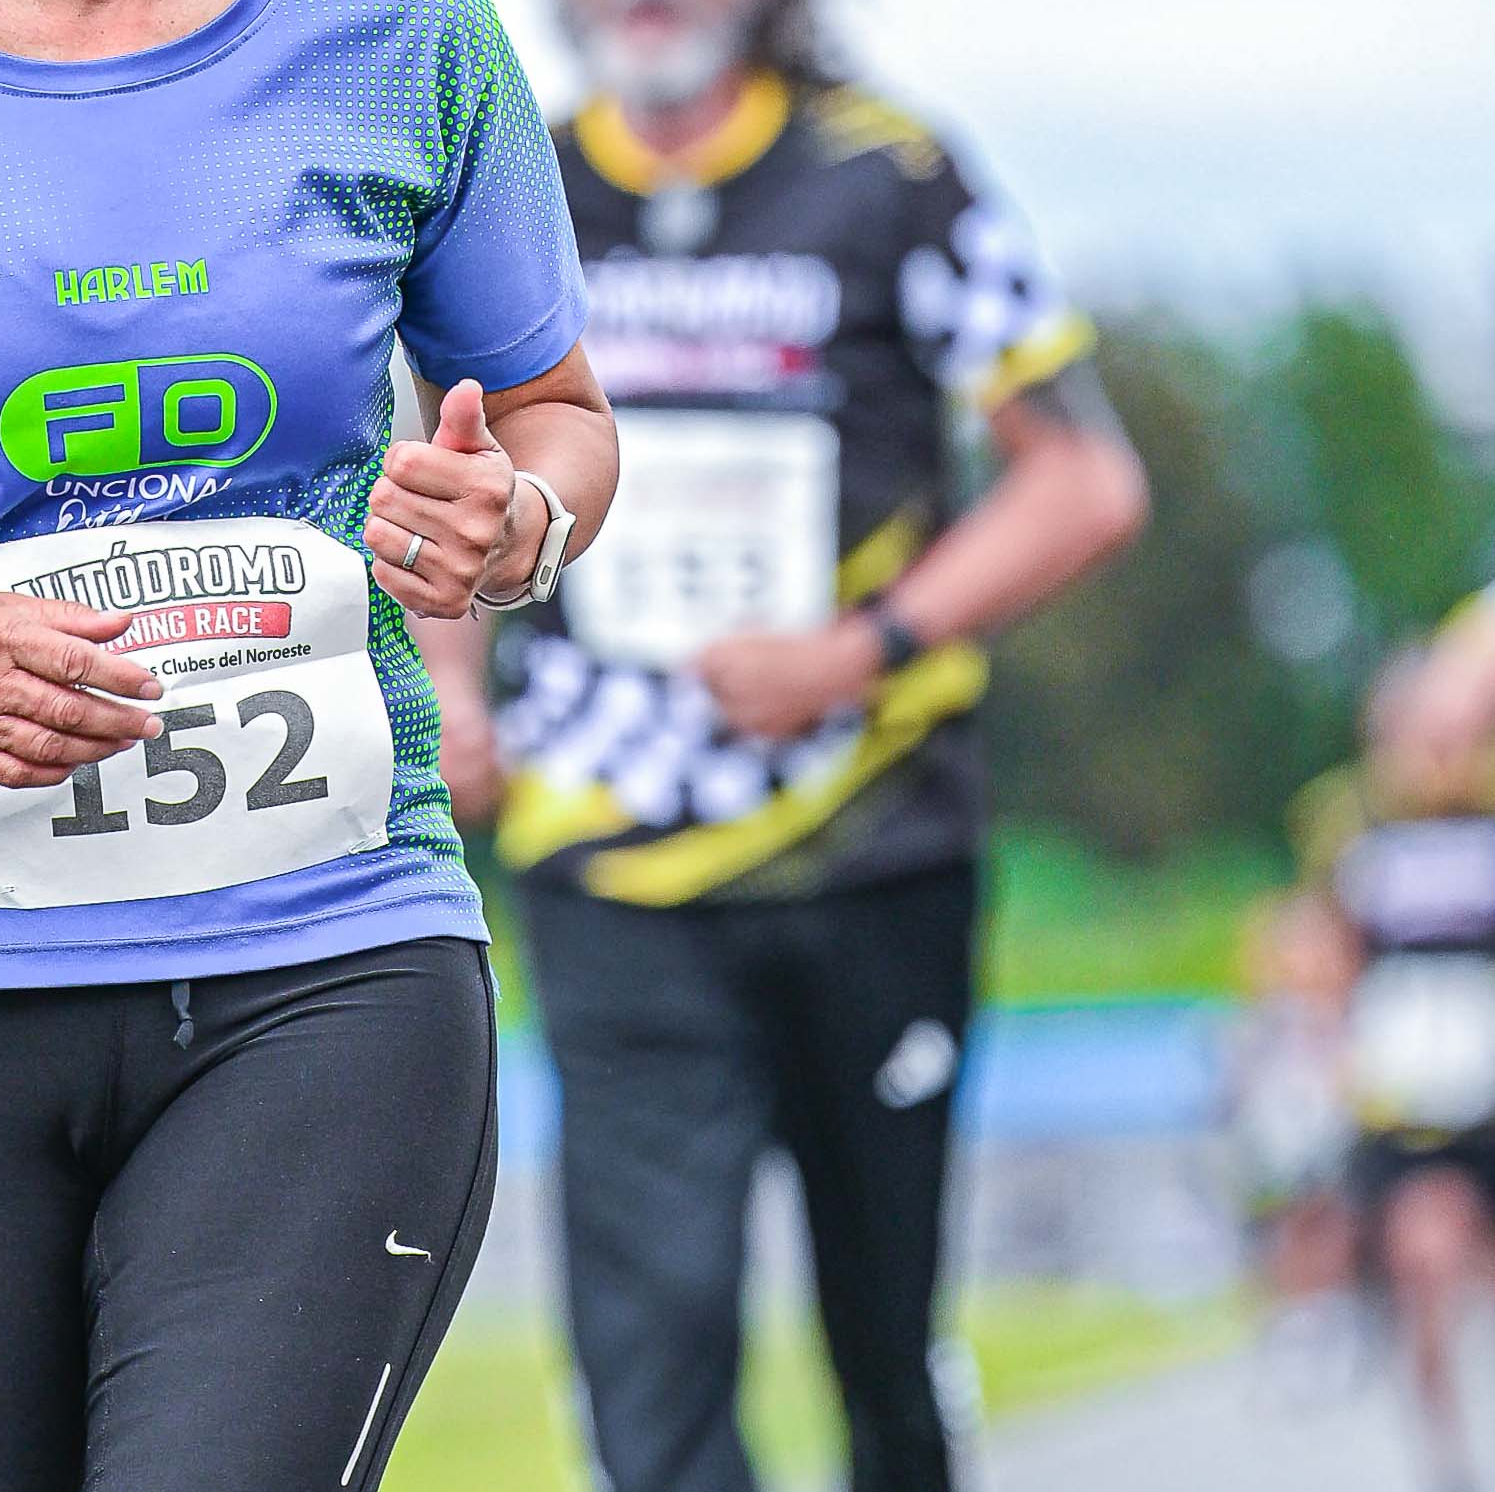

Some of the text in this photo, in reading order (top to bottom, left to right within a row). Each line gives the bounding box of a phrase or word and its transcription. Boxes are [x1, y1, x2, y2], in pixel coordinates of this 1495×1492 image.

[54, 258, 210, 306] HARLEM
[194, 606, 262, 635] RACE
[162, 657, 215, 675] Clubes
[218, 650, 242, 668] del
[246, 643, 312, 665] Noroeste
[51, 690, 328, 838] 152
